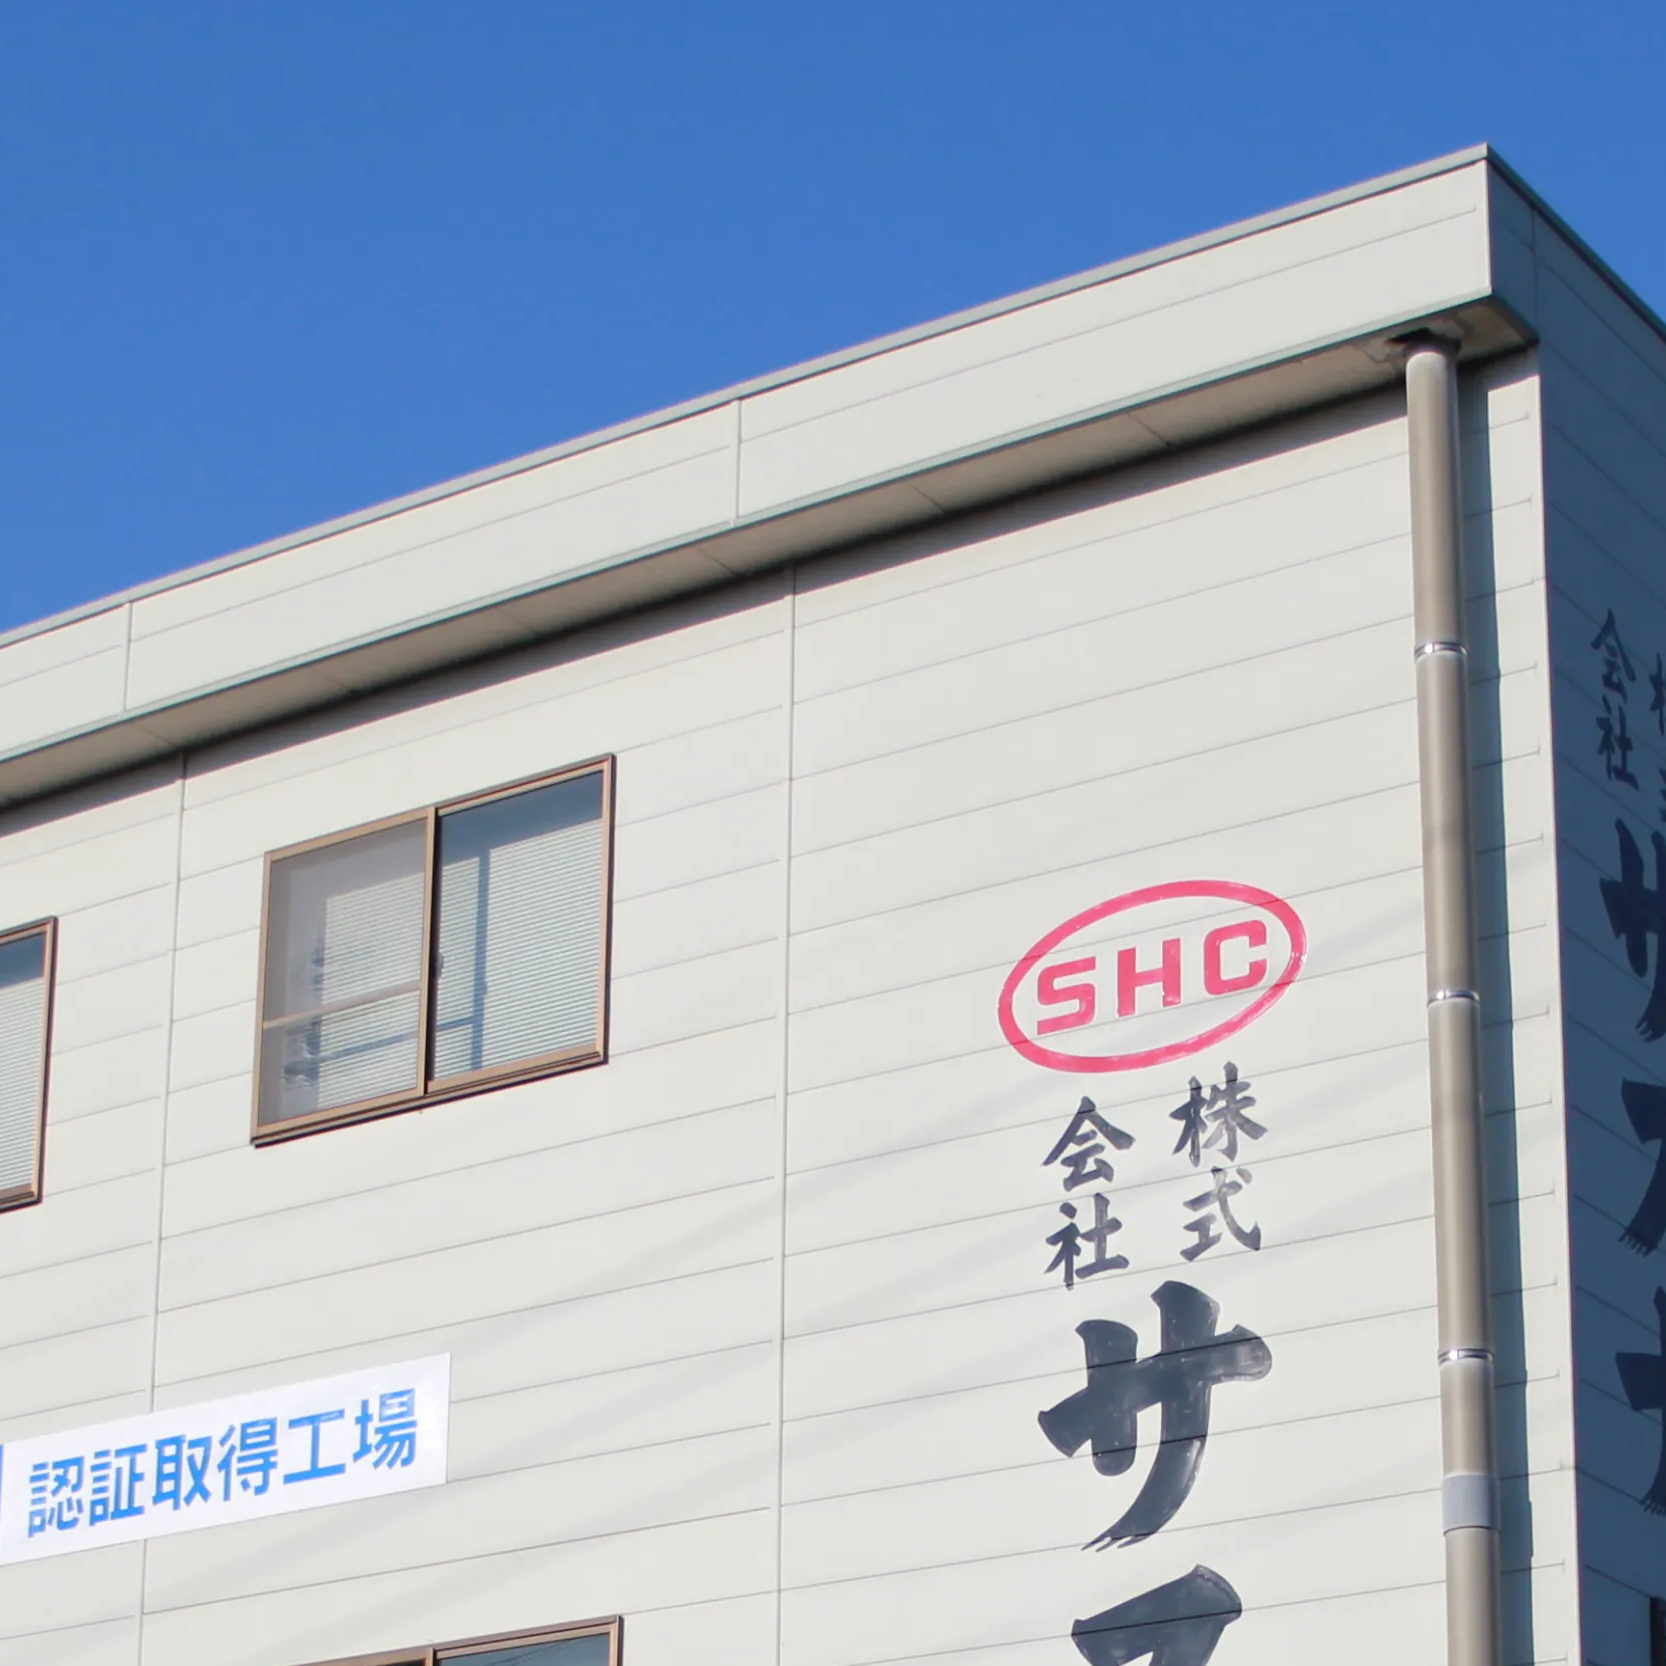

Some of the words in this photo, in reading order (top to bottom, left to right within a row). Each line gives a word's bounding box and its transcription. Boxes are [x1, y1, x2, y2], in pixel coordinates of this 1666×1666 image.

[1591, 608, 1638, 791] 会社
[1035, 918, 1271, 1037] SHC
[1044, 1097, 1133, 1290] 会社
[1170, 1063, 1267, 1264] 株式
[29, 1389, 417, 1537] 認証取得工場
